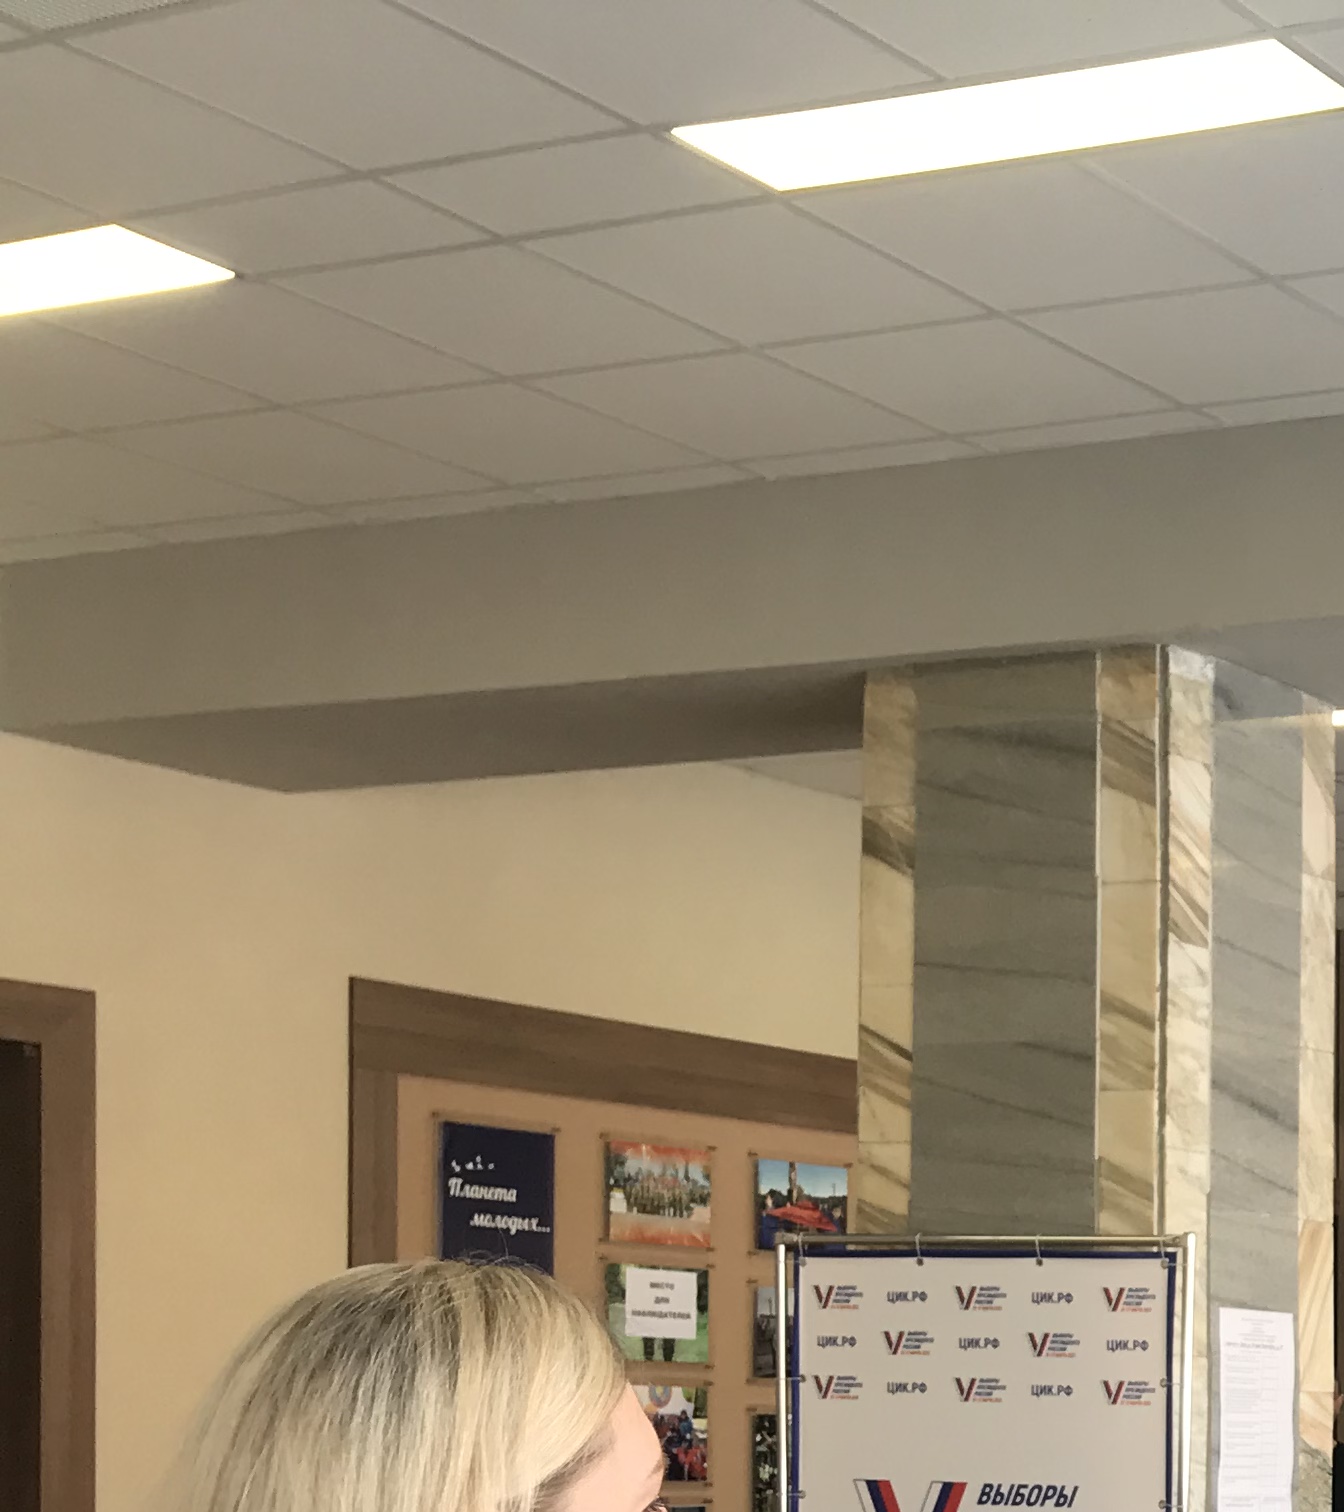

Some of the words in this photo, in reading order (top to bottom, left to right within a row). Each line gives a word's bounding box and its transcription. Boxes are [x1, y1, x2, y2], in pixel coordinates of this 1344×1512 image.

[448, 1177, 517, 1203] Планета
[887, 1291, 928, 1304] ЦИК.РФ
[1031, 1292, 1074, 1305] ЦИК.РФ
[817, 1336, 857, 1349] ЦИК.РФ
[959, 1337, 1000, 1350] ЦИК.РФ
[1106, 1340, 1149, 1352] ЦИК.РФ
[887, 1381, 927, 1395] ЦИК.РФ
[1031, 1384, 1073, 1397] ЦИК.РФ
[976, 1483, 1079, 1508] ВЫБОРЫ
